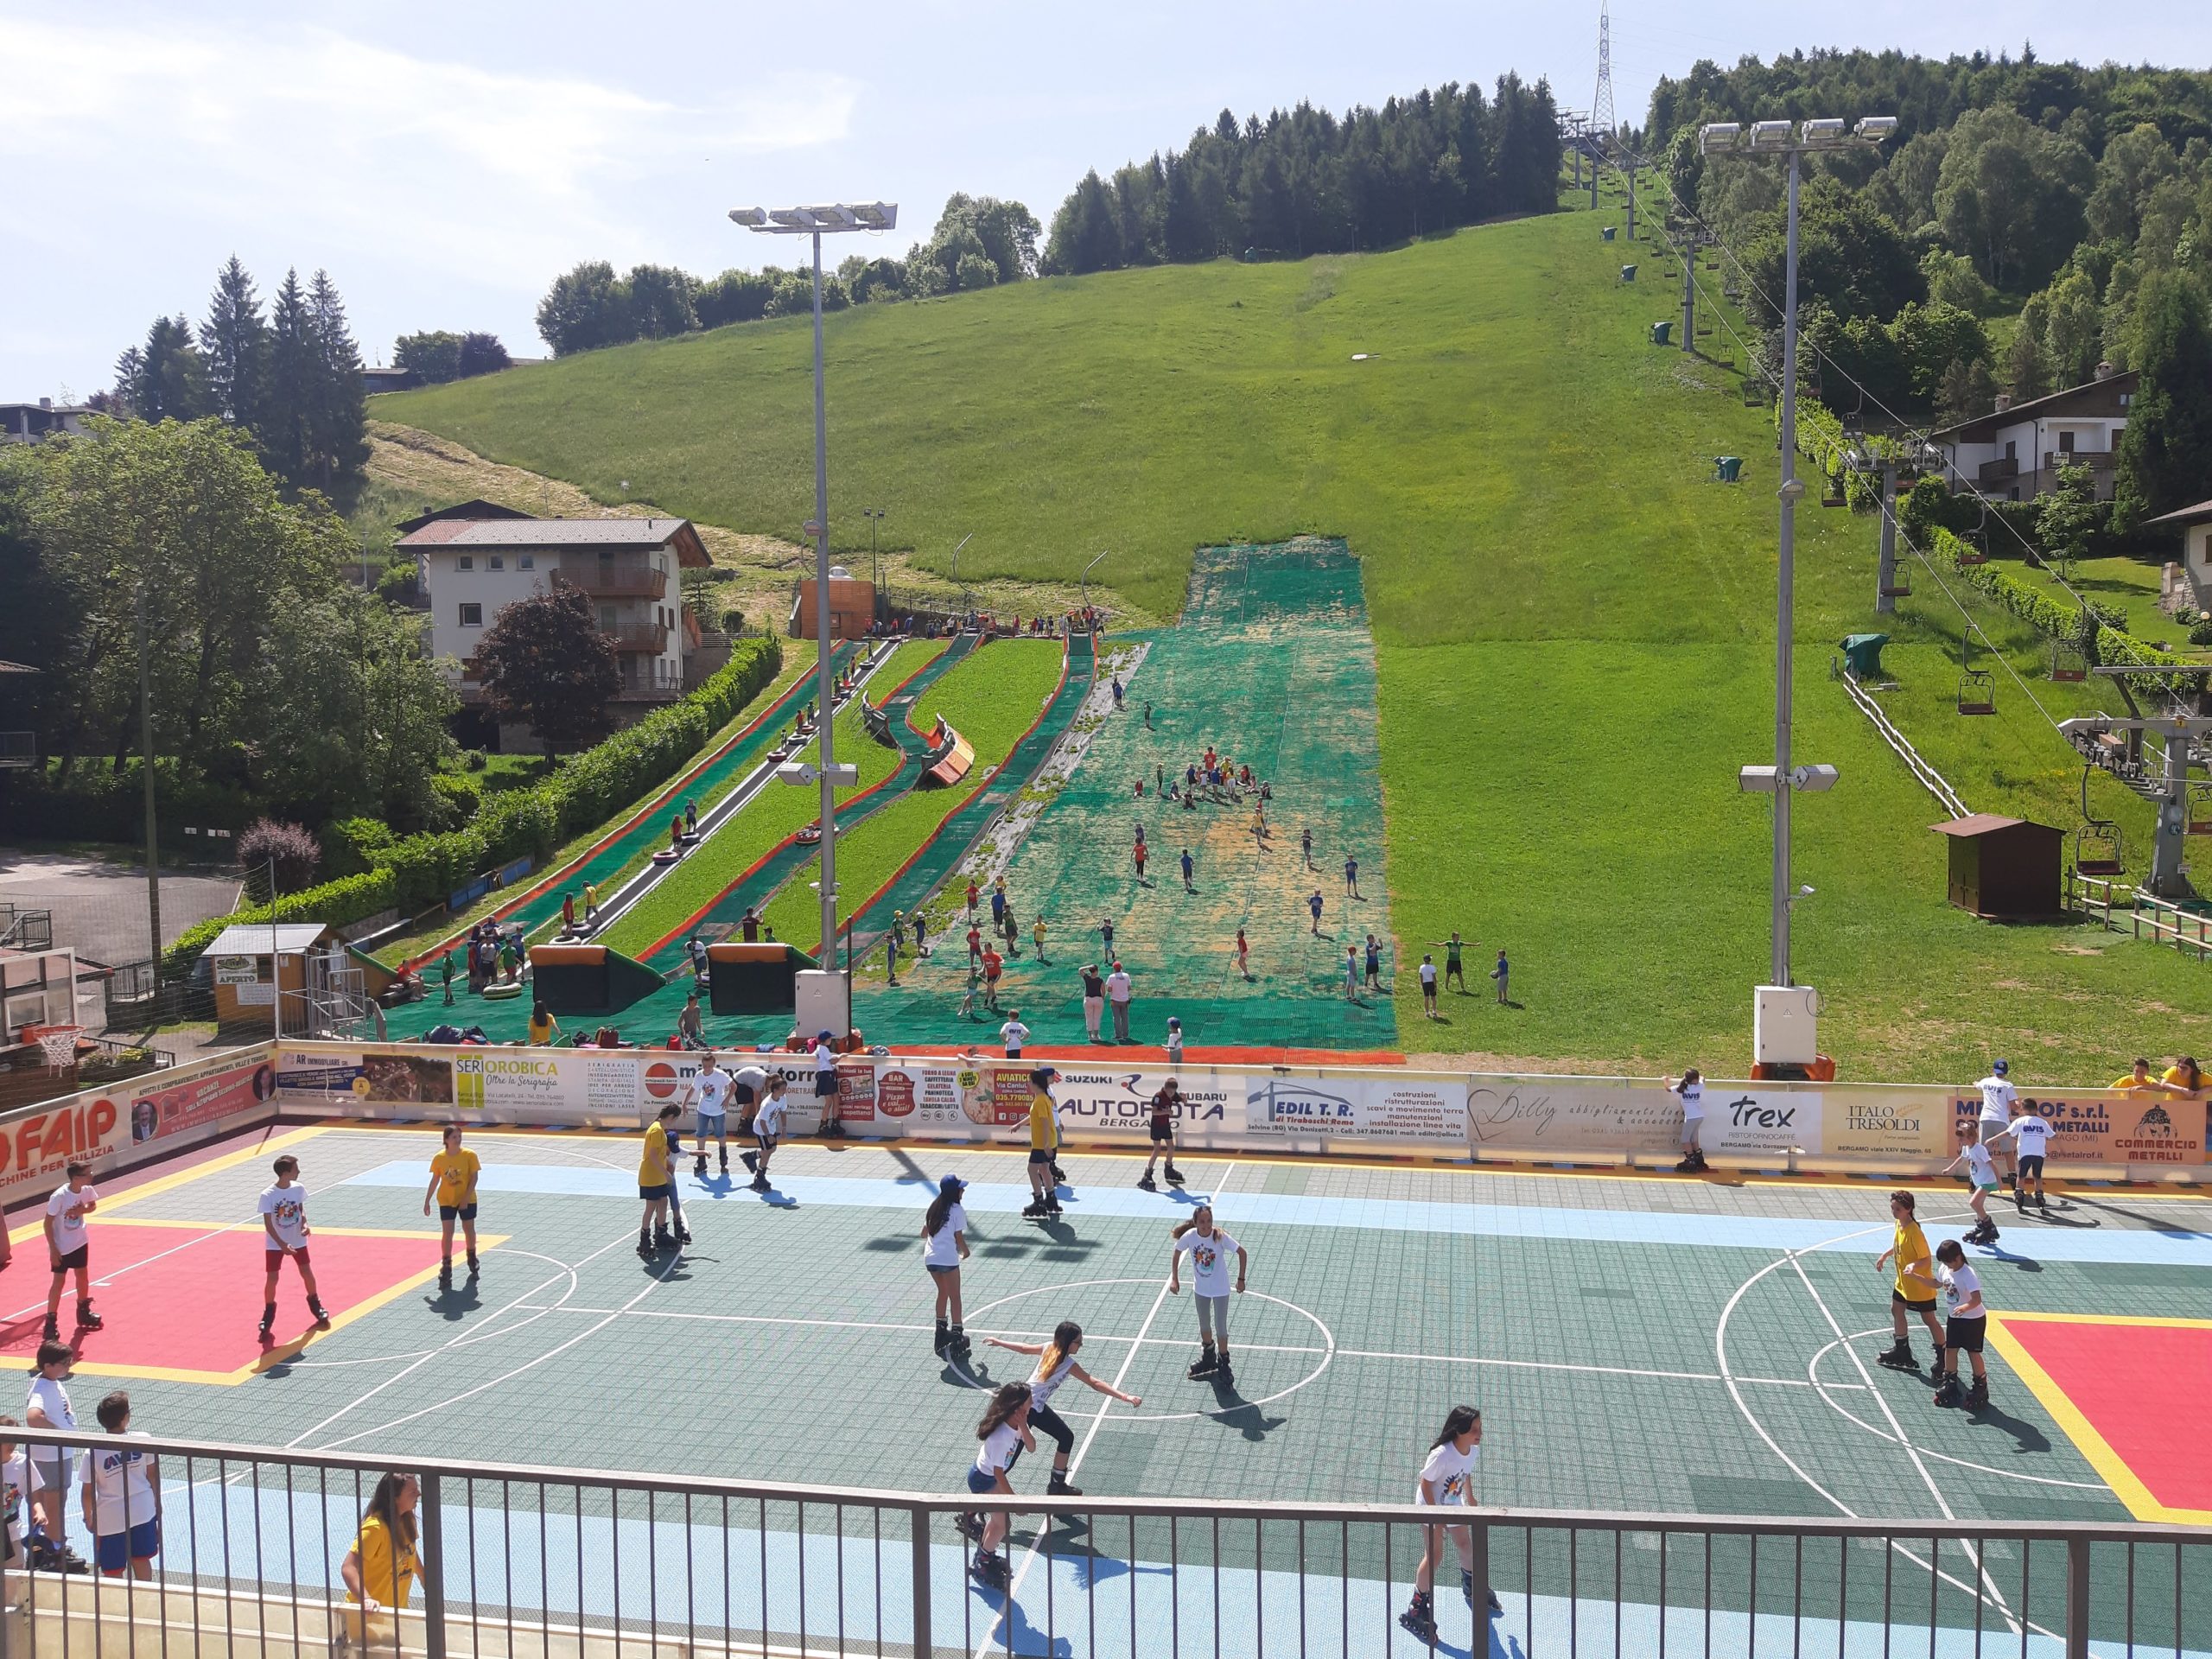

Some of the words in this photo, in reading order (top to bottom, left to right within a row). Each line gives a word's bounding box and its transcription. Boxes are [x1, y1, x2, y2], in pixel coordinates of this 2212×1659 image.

[296, 1054, 306, 1065] AR
[456, 1059, 558, 1076] SERIOROBICA
[486, 1074, 506, 1085] Oltre
[509, 1075, 516, 1084] la
[518, 1075, 558, 1090] Serigrafia
[1065, 1075, 1112, 1084] SUZUKI
[1186, 1092, 1227, 1101] UBARU
[1276, 1102, 1313, 1115] EDIL
[1319, 1103, 1331, 1116] T.
[1338, 1104, 1354, 1116] R.
[1569, 1104, 1655, 1117] abbigliamento
[1849, 1105, 1894, 1117] ITALO
[2070, 1104, 2109, 1119] s.r.l.
[1099, 1117, 1180, 1129] BERGAO
[1845, 1117, 1921, 1131] TRESOLDI
[2052, 1121, 2109, 1134] METALLI
[2115, 1140, 2197, 1149] COMMERCIO
[41, 1160, 65, 1174] PER
[67, 1145, 115, 1164] PULIZIA
[2128, 1151, 2183, 1160] METALLI
